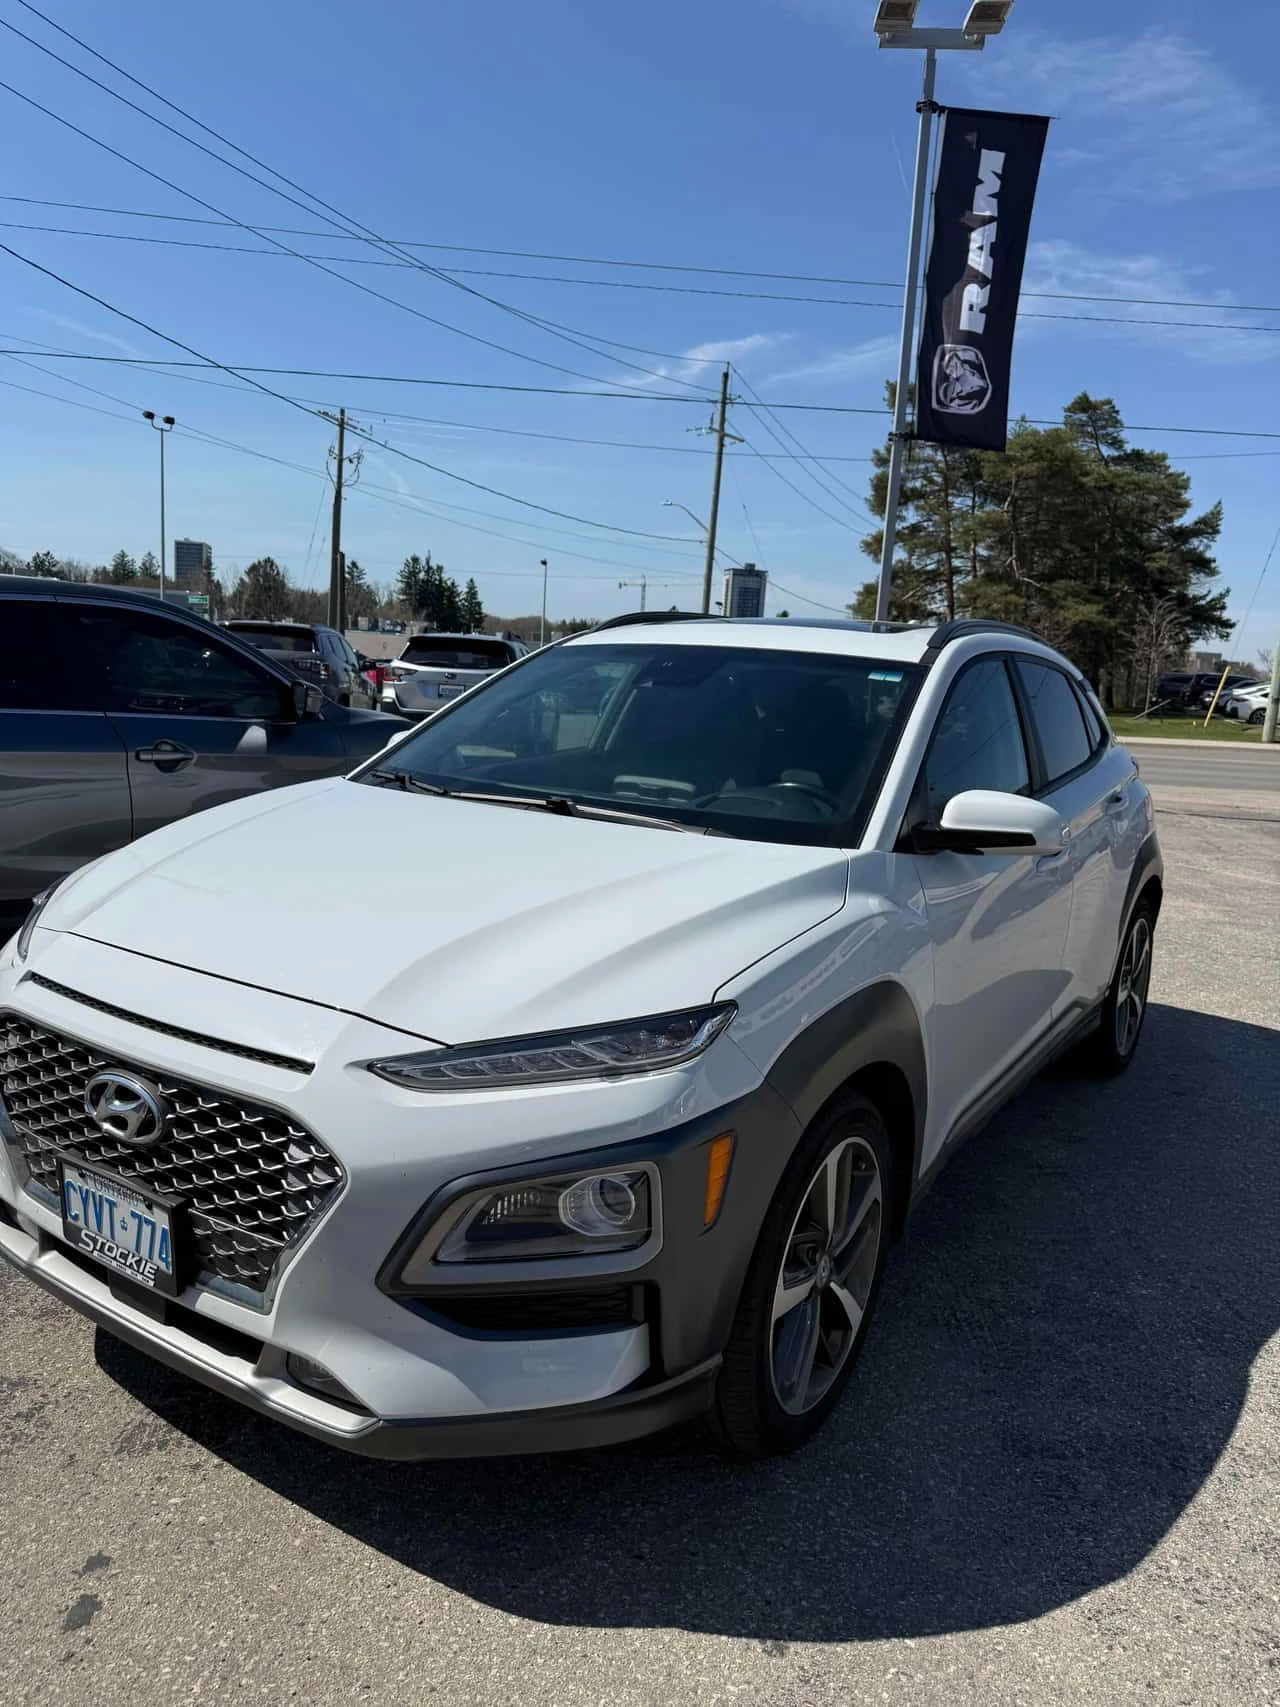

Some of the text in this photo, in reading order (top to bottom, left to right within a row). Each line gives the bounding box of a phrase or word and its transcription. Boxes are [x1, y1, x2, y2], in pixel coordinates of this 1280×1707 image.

[959, 148, 1006, 335] RAM
[64, 1179, 117, 1240] CYVT
[78, 1229, 158, 1279] STOCKIE
